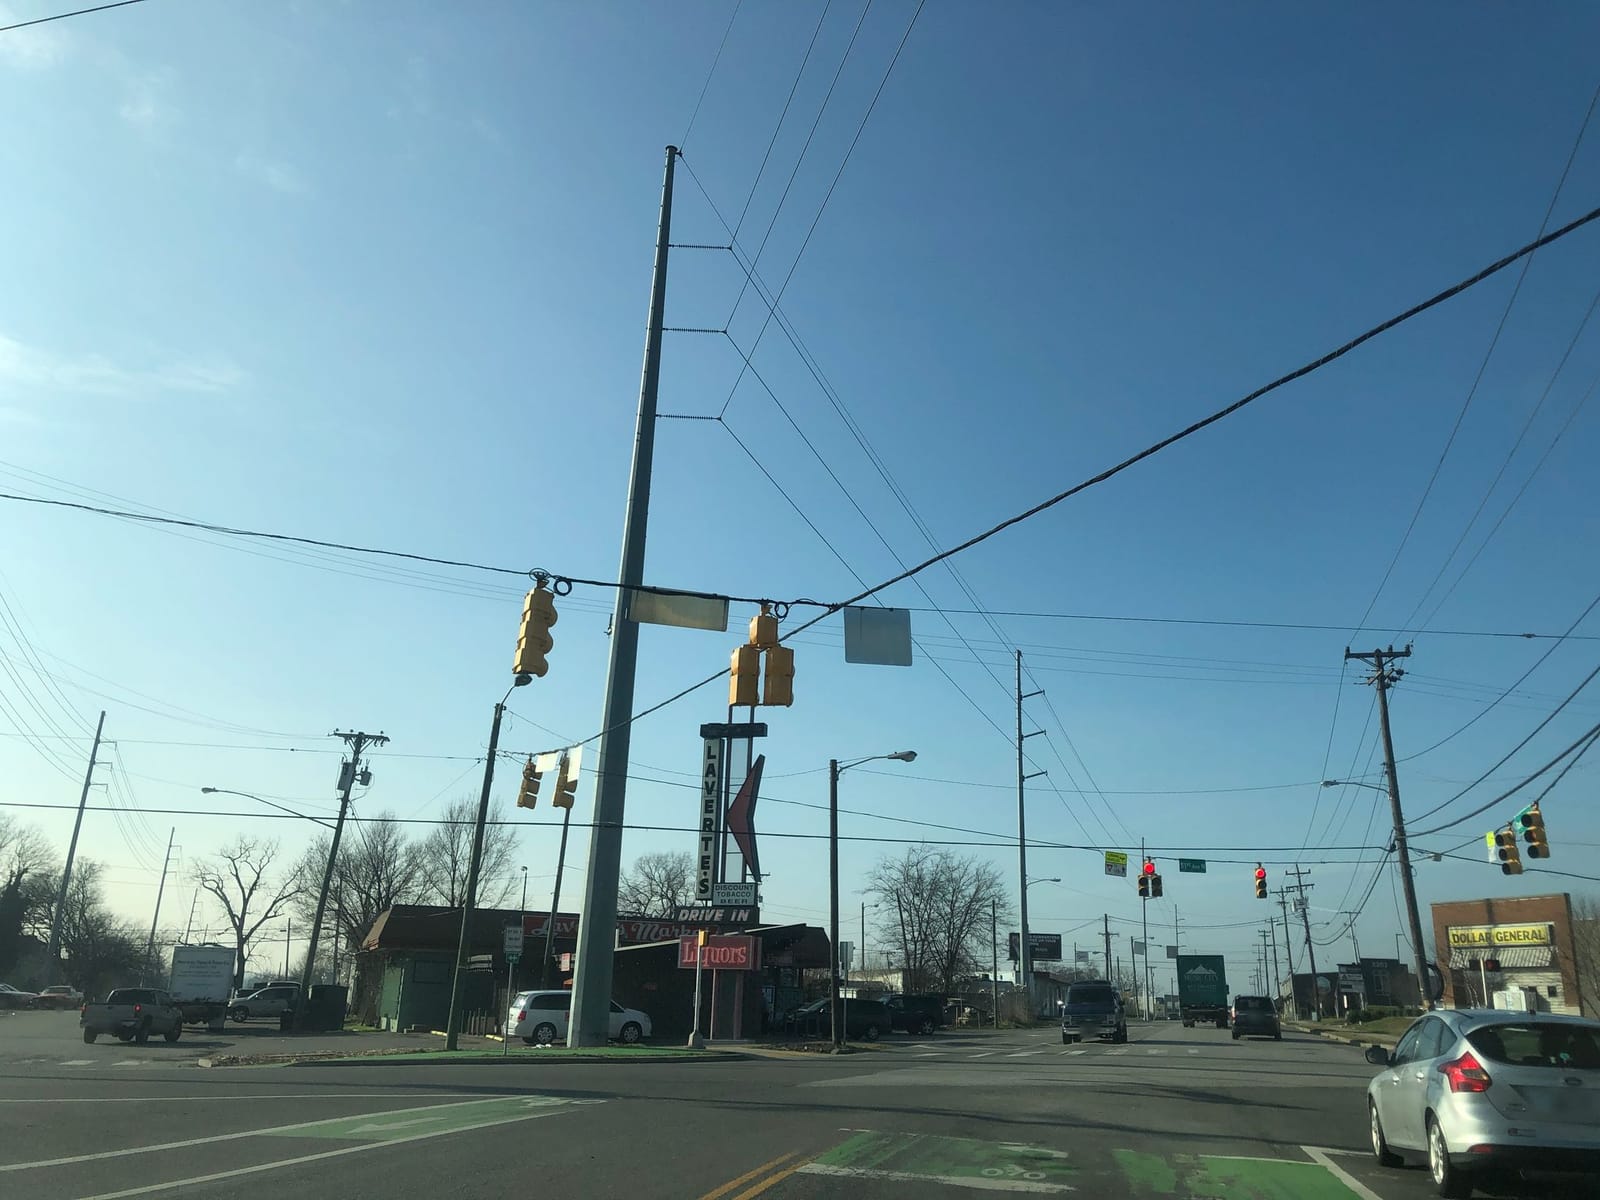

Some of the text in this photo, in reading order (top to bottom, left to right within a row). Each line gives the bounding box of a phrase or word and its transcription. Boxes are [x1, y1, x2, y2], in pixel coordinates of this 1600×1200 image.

[699, 746, 717, 894] LAVERTE'S
[715, 883, 754, 892] DISCOUNT
[678, 909, 750, 922] DRIVE IN
[1451, 928, 1546, 944] DOLLAR GENERAL
[682, 939, 747, 967] Liquors
